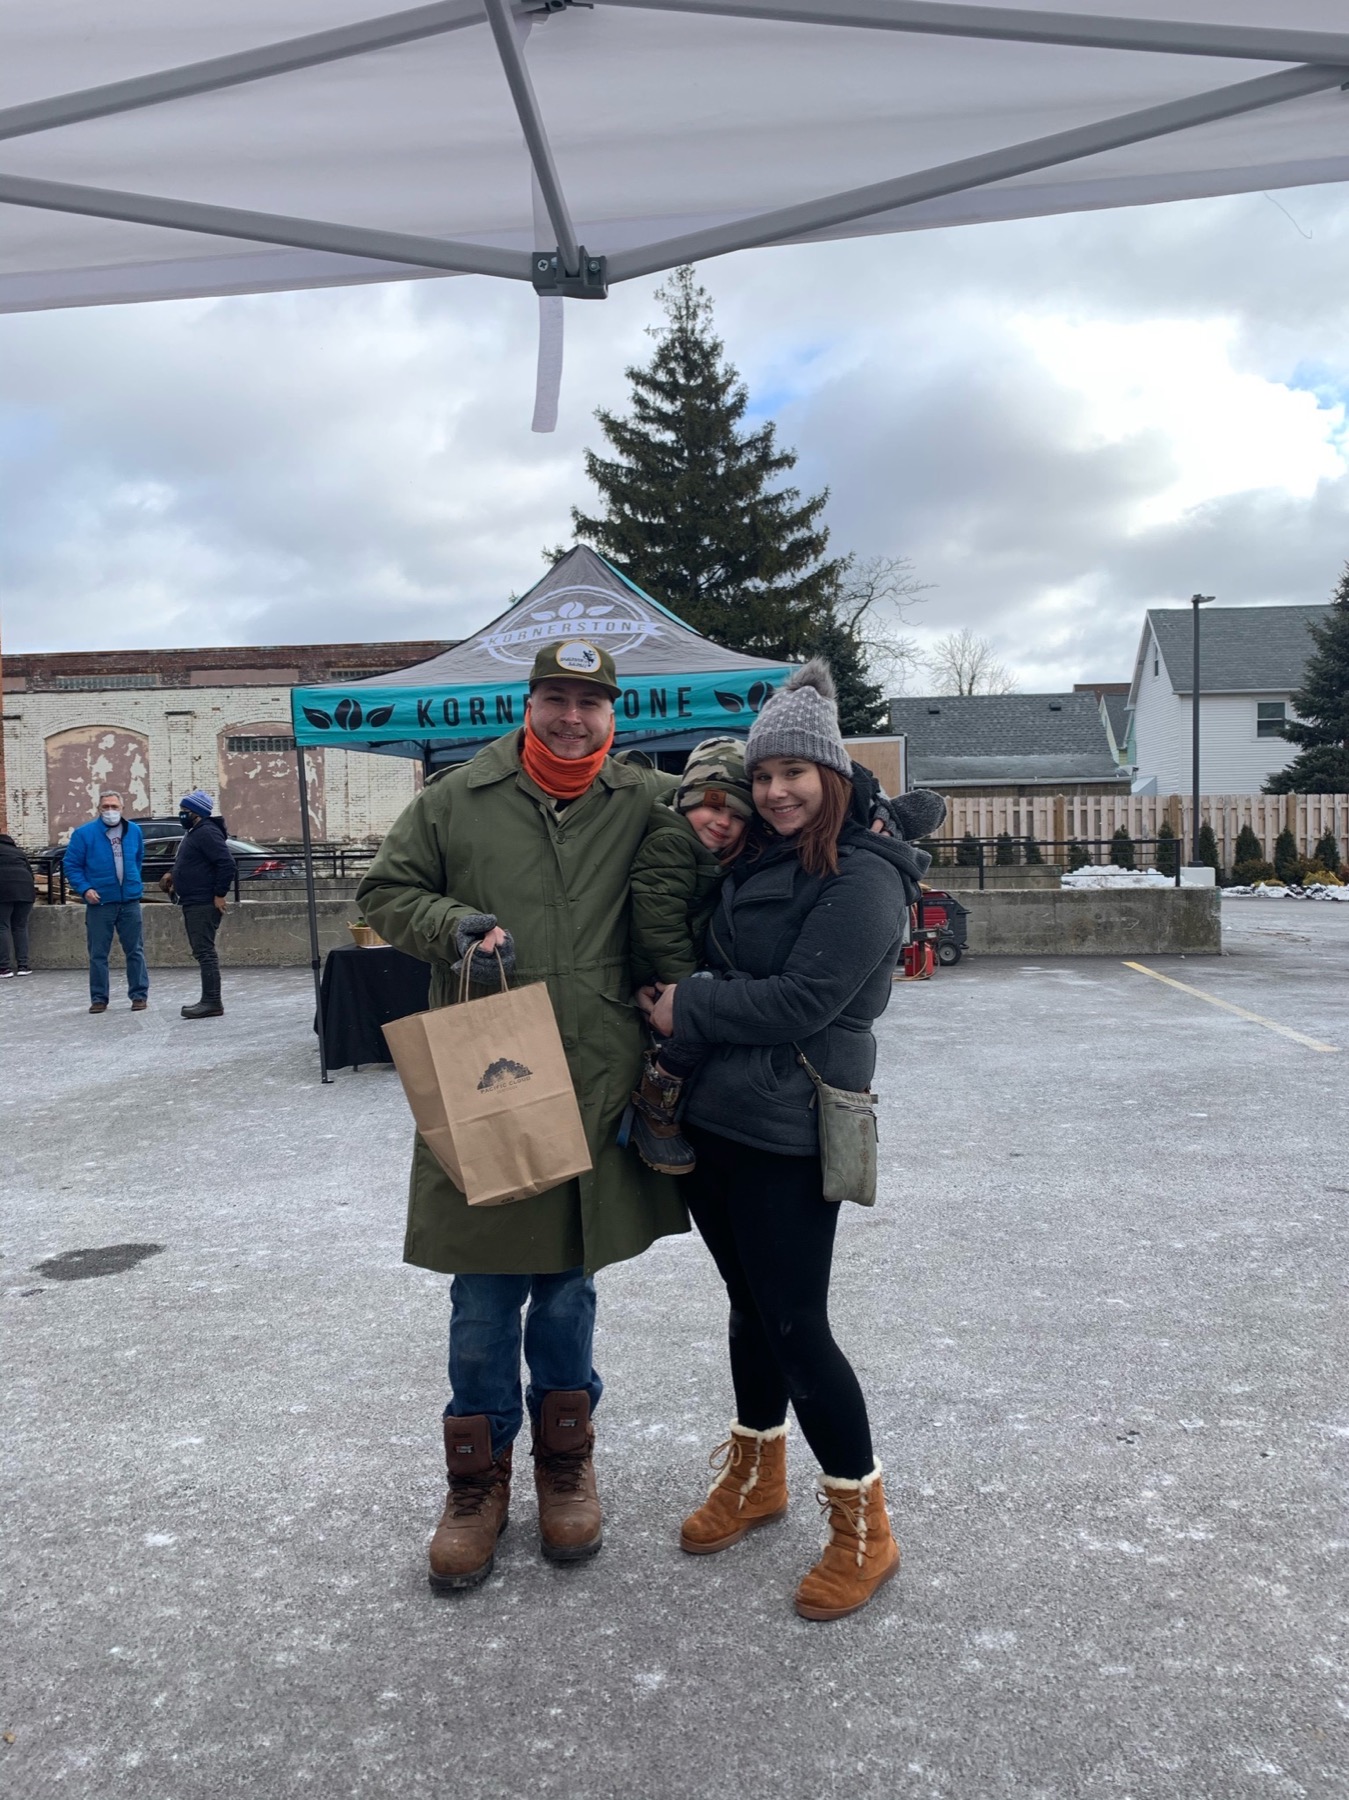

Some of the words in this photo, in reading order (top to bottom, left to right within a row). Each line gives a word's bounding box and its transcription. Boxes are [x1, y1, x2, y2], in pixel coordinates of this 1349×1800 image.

[488, 620, 647, 646] KORNERSTONE
[417, 686, 692, 728] KORNONE
[480, 1082, 507, 1095] PACIFIC
[508, 1076, 531, 1086] CLOUD
